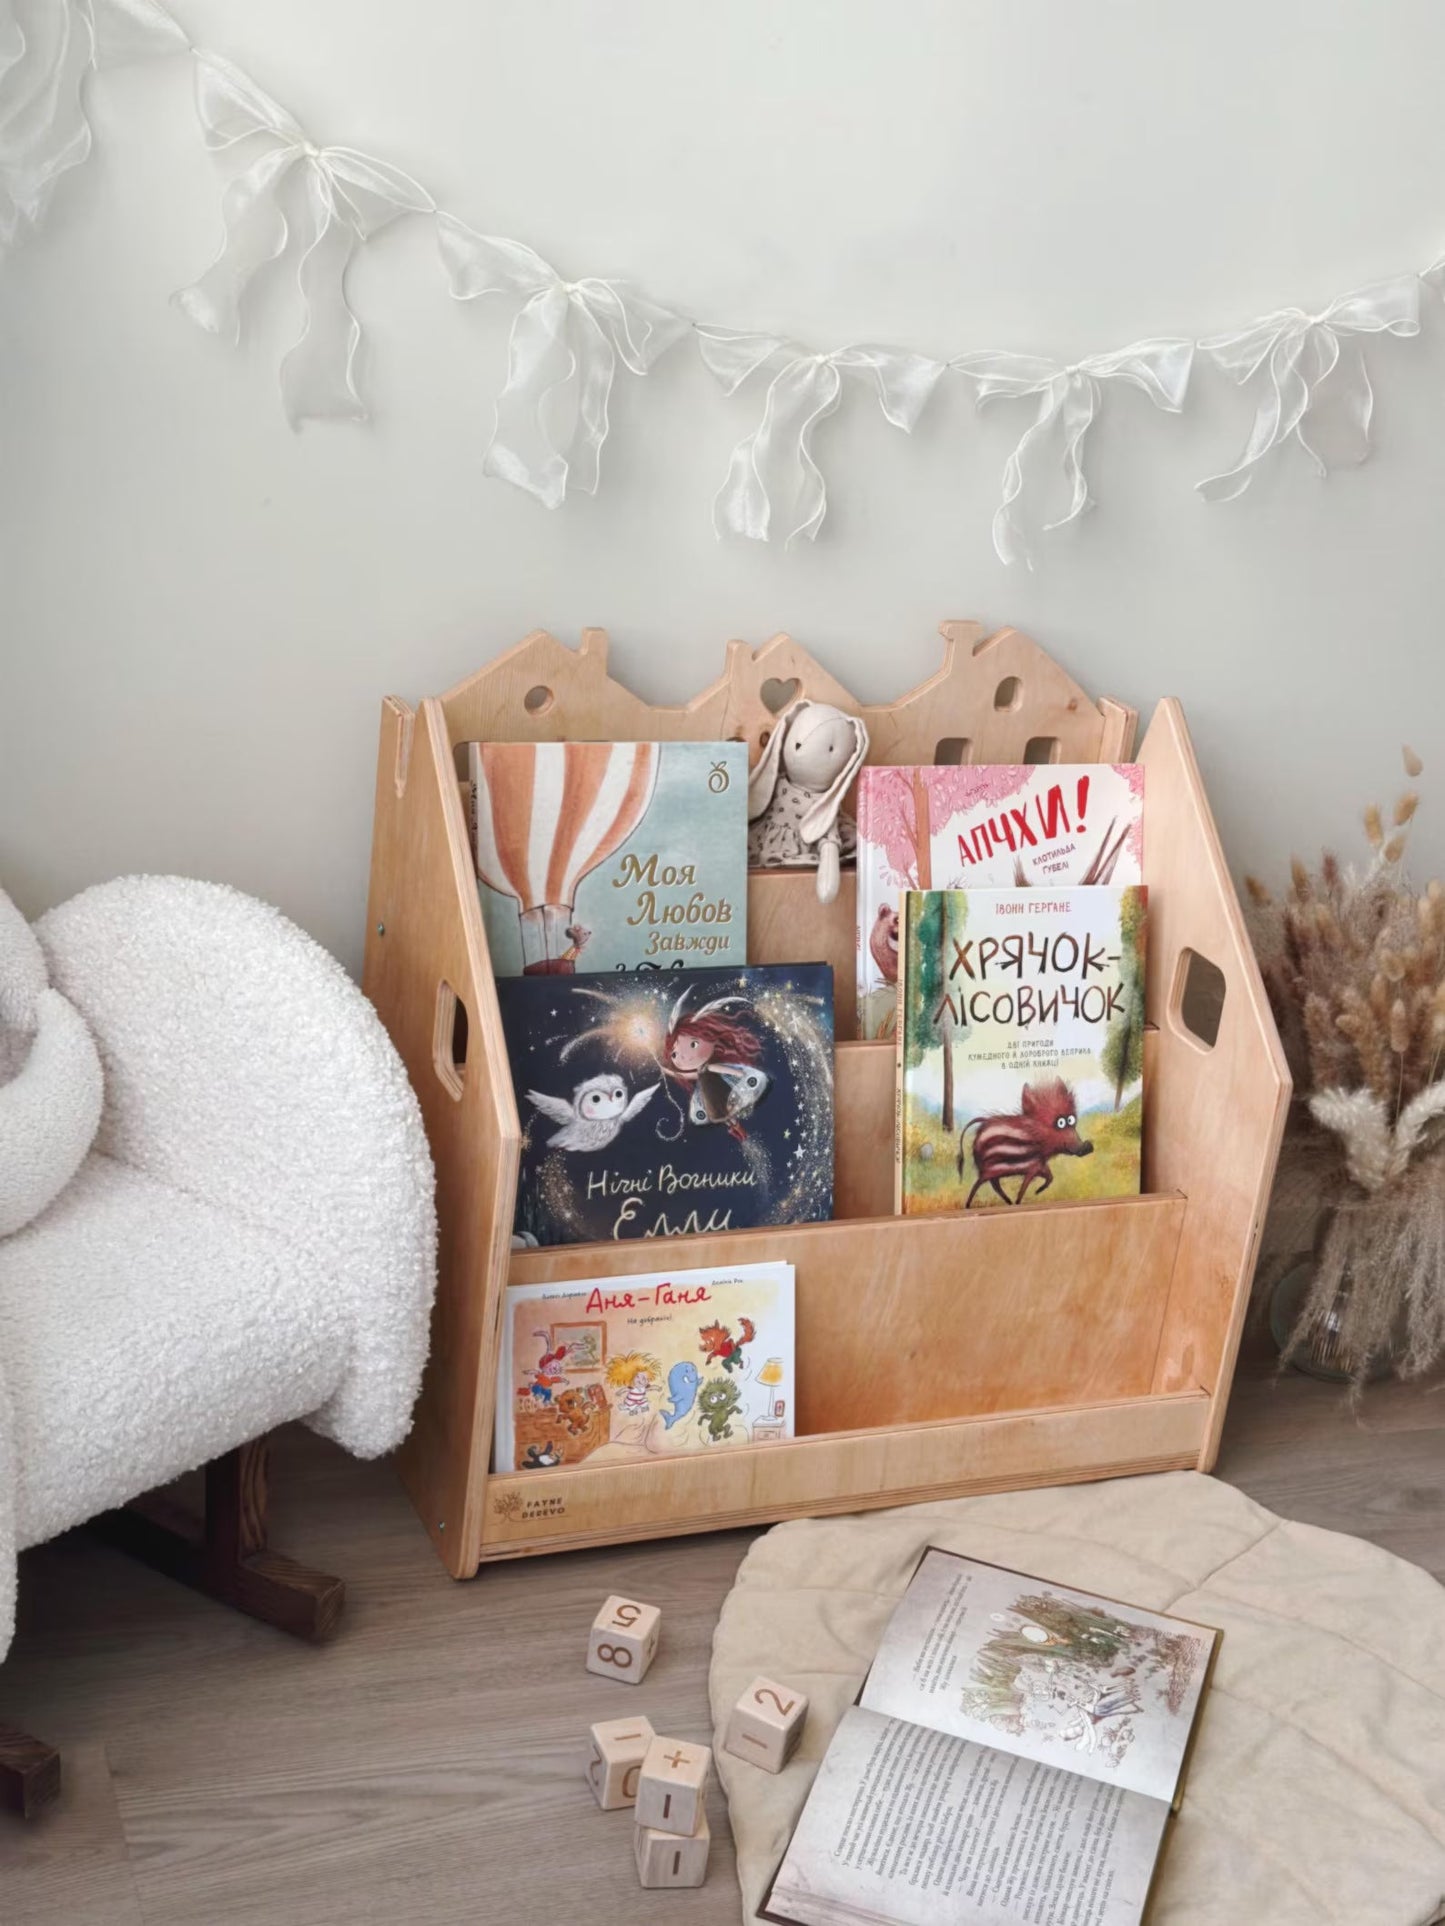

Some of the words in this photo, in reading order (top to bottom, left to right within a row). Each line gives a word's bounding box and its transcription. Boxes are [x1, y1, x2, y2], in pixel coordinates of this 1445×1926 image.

[957, 775, 1090, 868] АПЧХИ!
[612, 853, 696, 888] Моя
[627, 891, 732, 925] Любов
[645, 931, 730, 956] Завжди
[949, 932, 1122, 980] ХРЯЧОК-
[932, 982, 1126, 1029] ЛІСОВИЧОК
[587, 1169, 652, 1199] Нічні
[658, 1163, 757, 1194] Вогники
[521, 1507, 566, 1519] DEREVO
[526, 1497, 563, 1508] FAYNE
